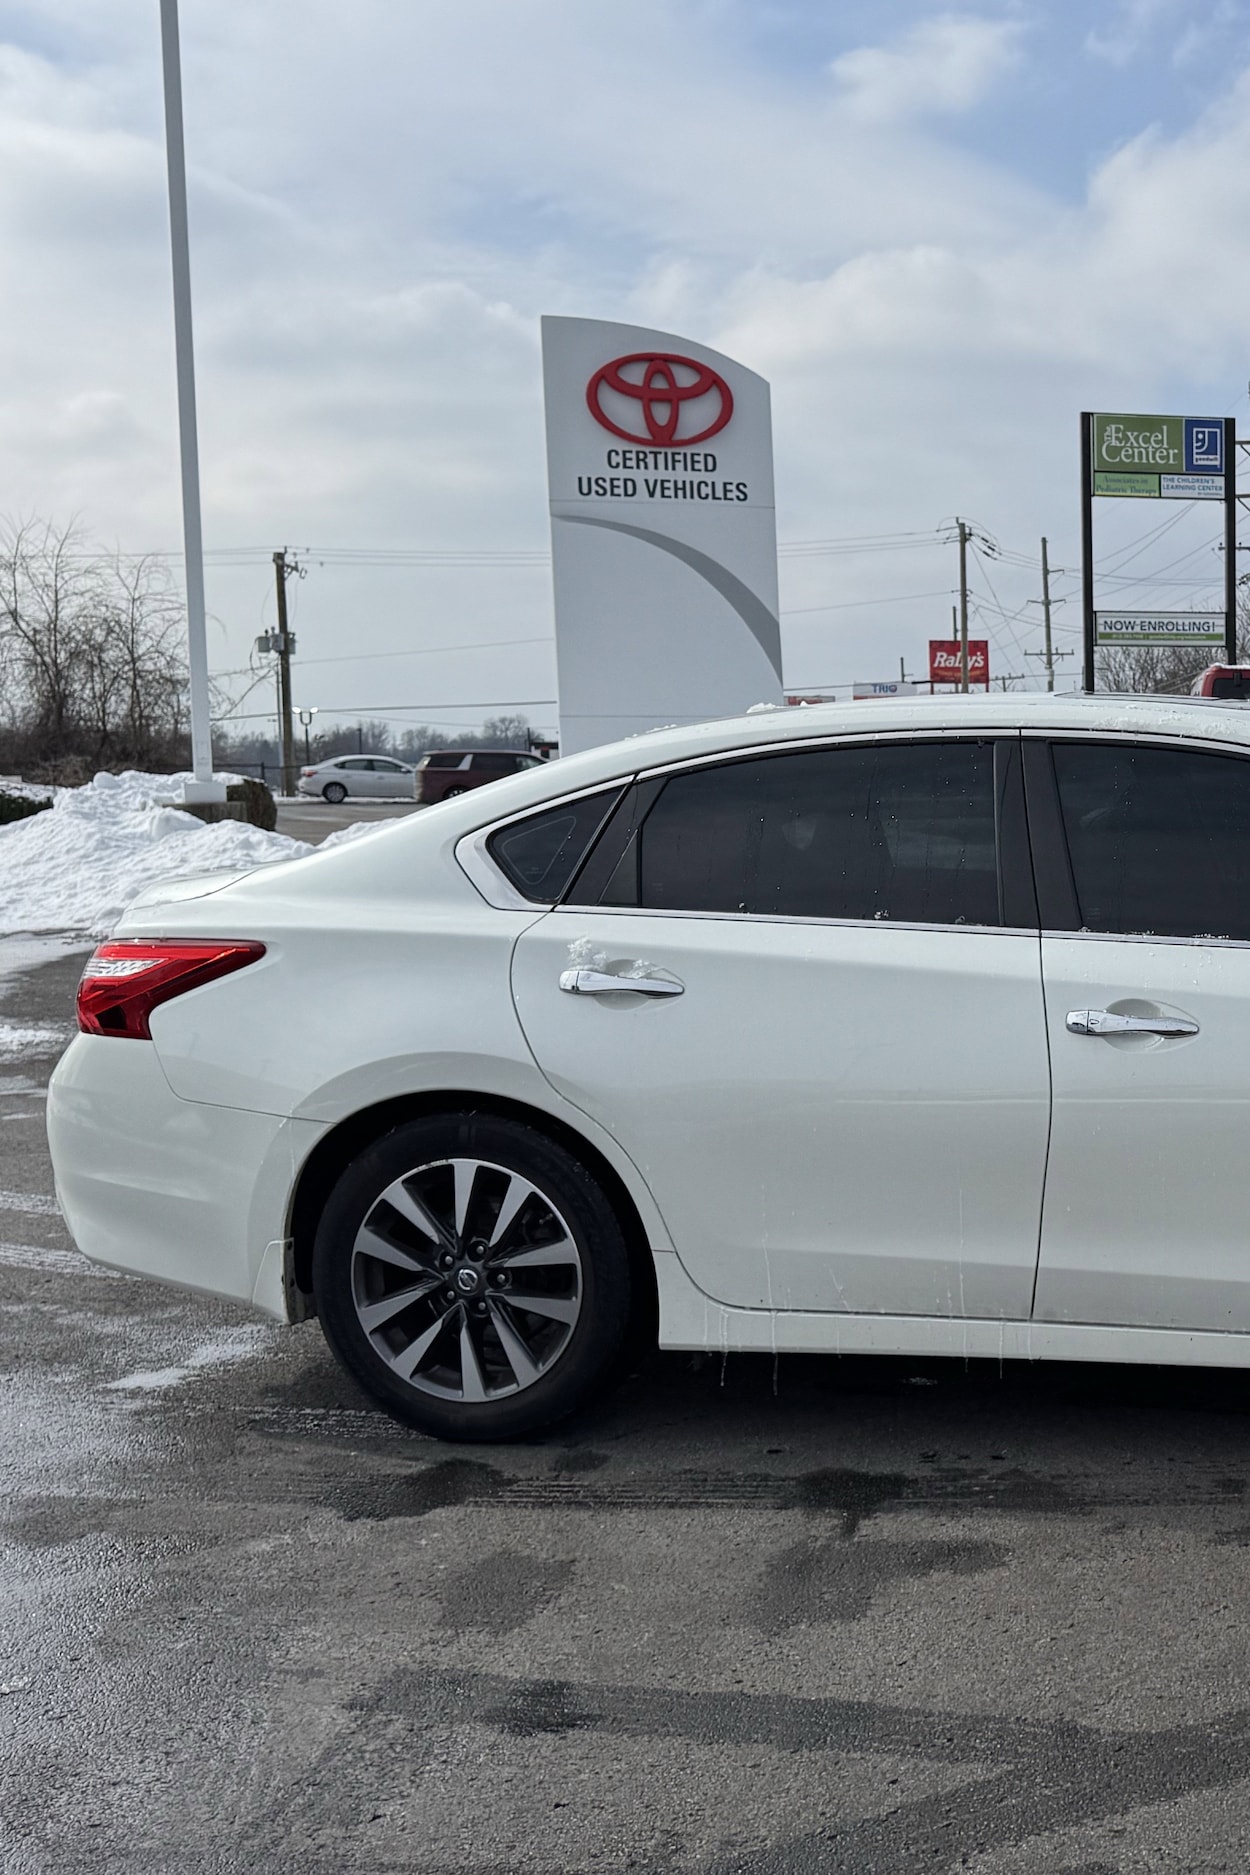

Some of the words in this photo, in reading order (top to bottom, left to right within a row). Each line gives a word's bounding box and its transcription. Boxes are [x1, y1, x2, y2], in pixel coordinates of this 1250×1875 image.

[1109, 424, 1168, 448] Excel
[607, 449, 717, 473] CERTIFIED
[1102, 441, 1179, 464] Center
[577, 476, 637, 498] USED
[644, 479, 748, 502] VEHICLES
[1177, 477, 1215, 485] CHILDREN'S
[1103, 620, 1137, 631] NOW
[1140, 620, 1215, 632] ENROLLING!
[933, 651, 985, 670] Raly's
[871, 683, 898, 693] TRIO
